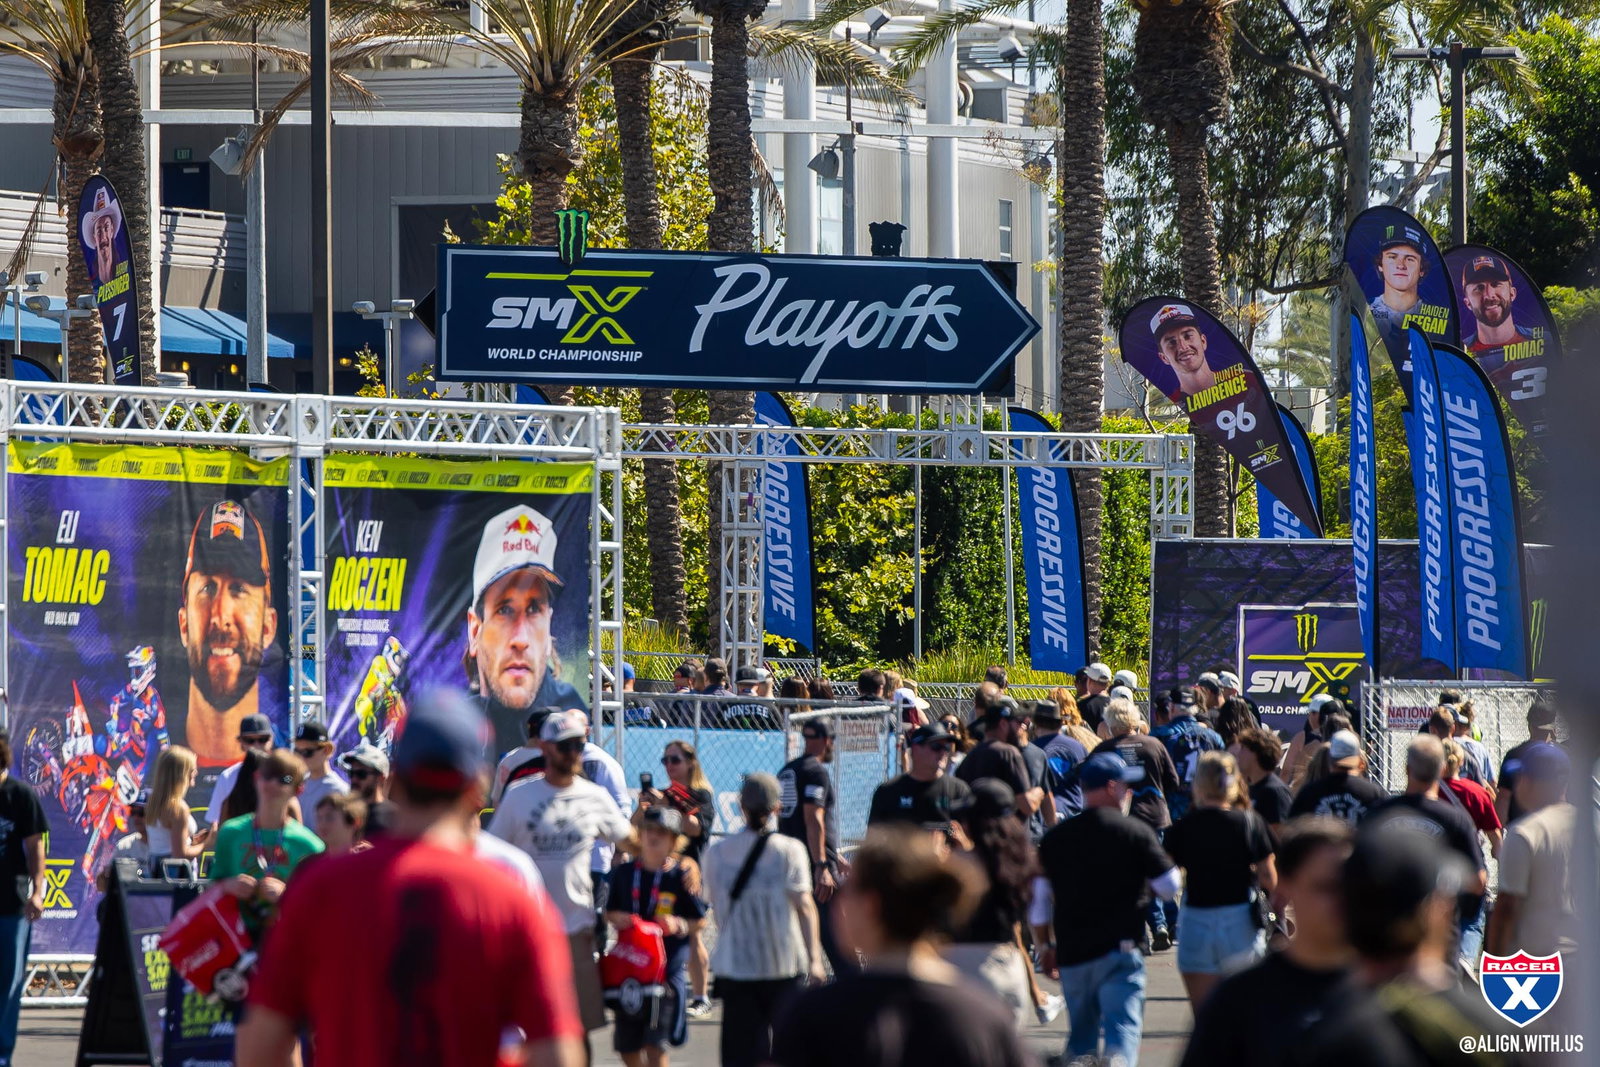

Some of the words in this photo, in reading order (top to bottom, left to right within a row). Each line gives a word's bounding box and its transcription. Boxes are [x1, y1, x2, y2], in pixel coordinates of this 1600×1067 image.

[112, 303, 127, 342] 7
[485, 285, 643, 345] SMX
[688, 263, 962, 384] Playoffs
[1420, 303, 1450, 319] HAIDEN
[1532, 326, 1544, 339] ELI
[487, 347, 536, 361] WORLD
[538, 348, 643, 362] CHAMPIONSHIP
[1503, 339, 1544, 362] TOMAC
[1213, 362, 1244, 385] HUNTER
[1510, 366, 1547, 401] 3
[1186, 374, 1248, 413] LAWRENCE
[1216, 402, 1257, 440] 96
[204, 465, 225, 478] TOMAC
[1250, 447, 1280, 467] SMX
[55, 509, 80, 544] ELI
[1419, 377, 1442, 642] PROGRESSIVE
[1442, 390, 1502, 651] PROGRESSIVE
[355, 519, 384, 552] KEN
[502, 538, 522, 553] Red
[1030, 463, 1068, 654] ROGRESSIVE
[22, 546, 111, 606] TOMAC
[327, 556, 407, 611] ROCZEN
[44, 610, 55, 625] RED
[1257, 705, 1284, 714] ORLD
[1387, 706, 1434, 719] NATIONA
